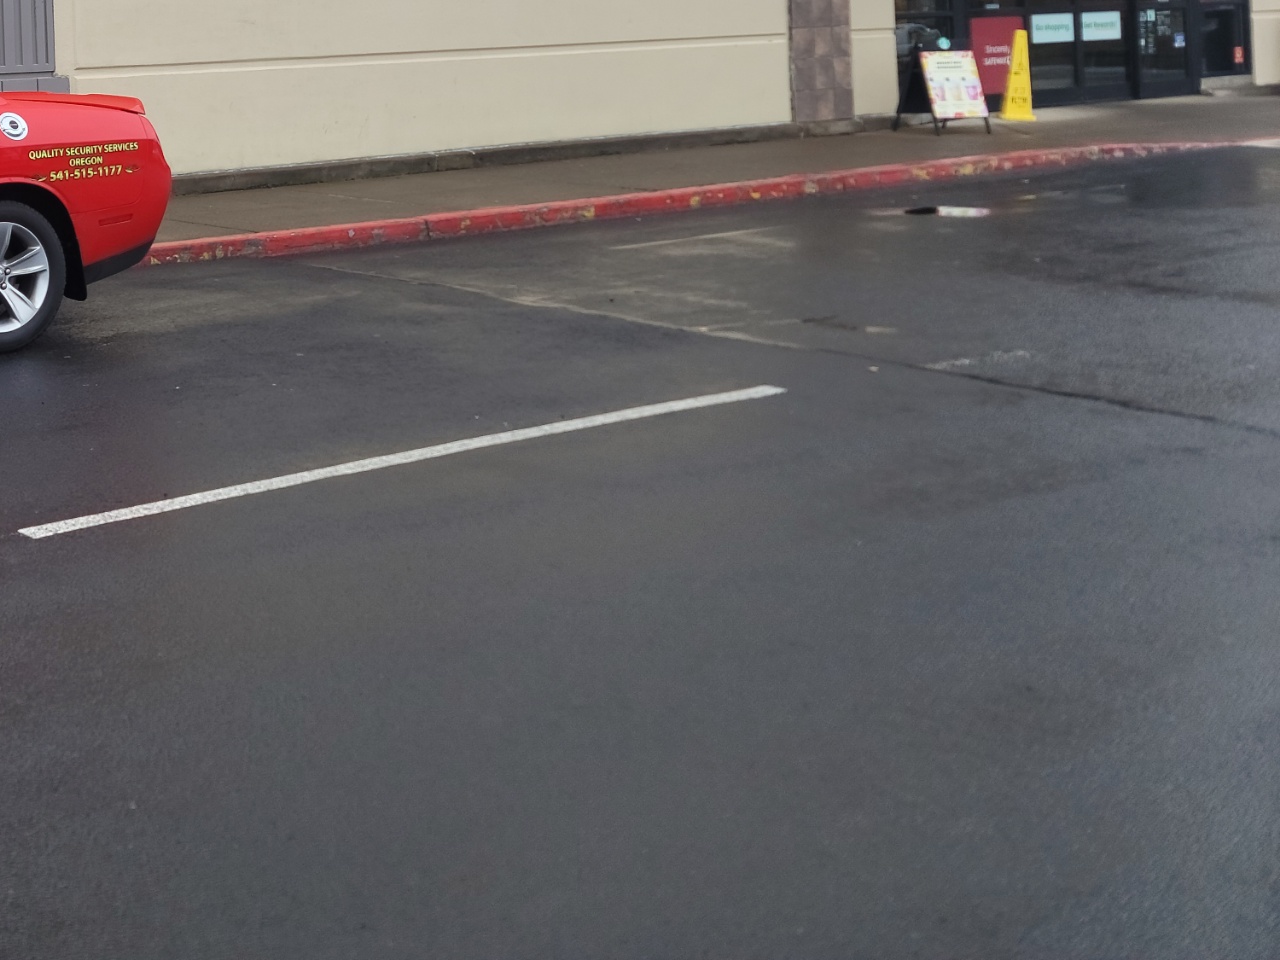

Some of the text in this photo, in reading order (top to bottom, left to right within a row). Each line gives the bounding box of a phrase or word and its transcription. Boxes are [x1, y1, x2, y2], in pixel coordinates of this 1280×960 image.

[28, 141, 139, 160] QUALITY SECURITY SERVICES
[69, 156, 103, 167] OREGON
[49, 165, 122, 182] 541-515-1177
